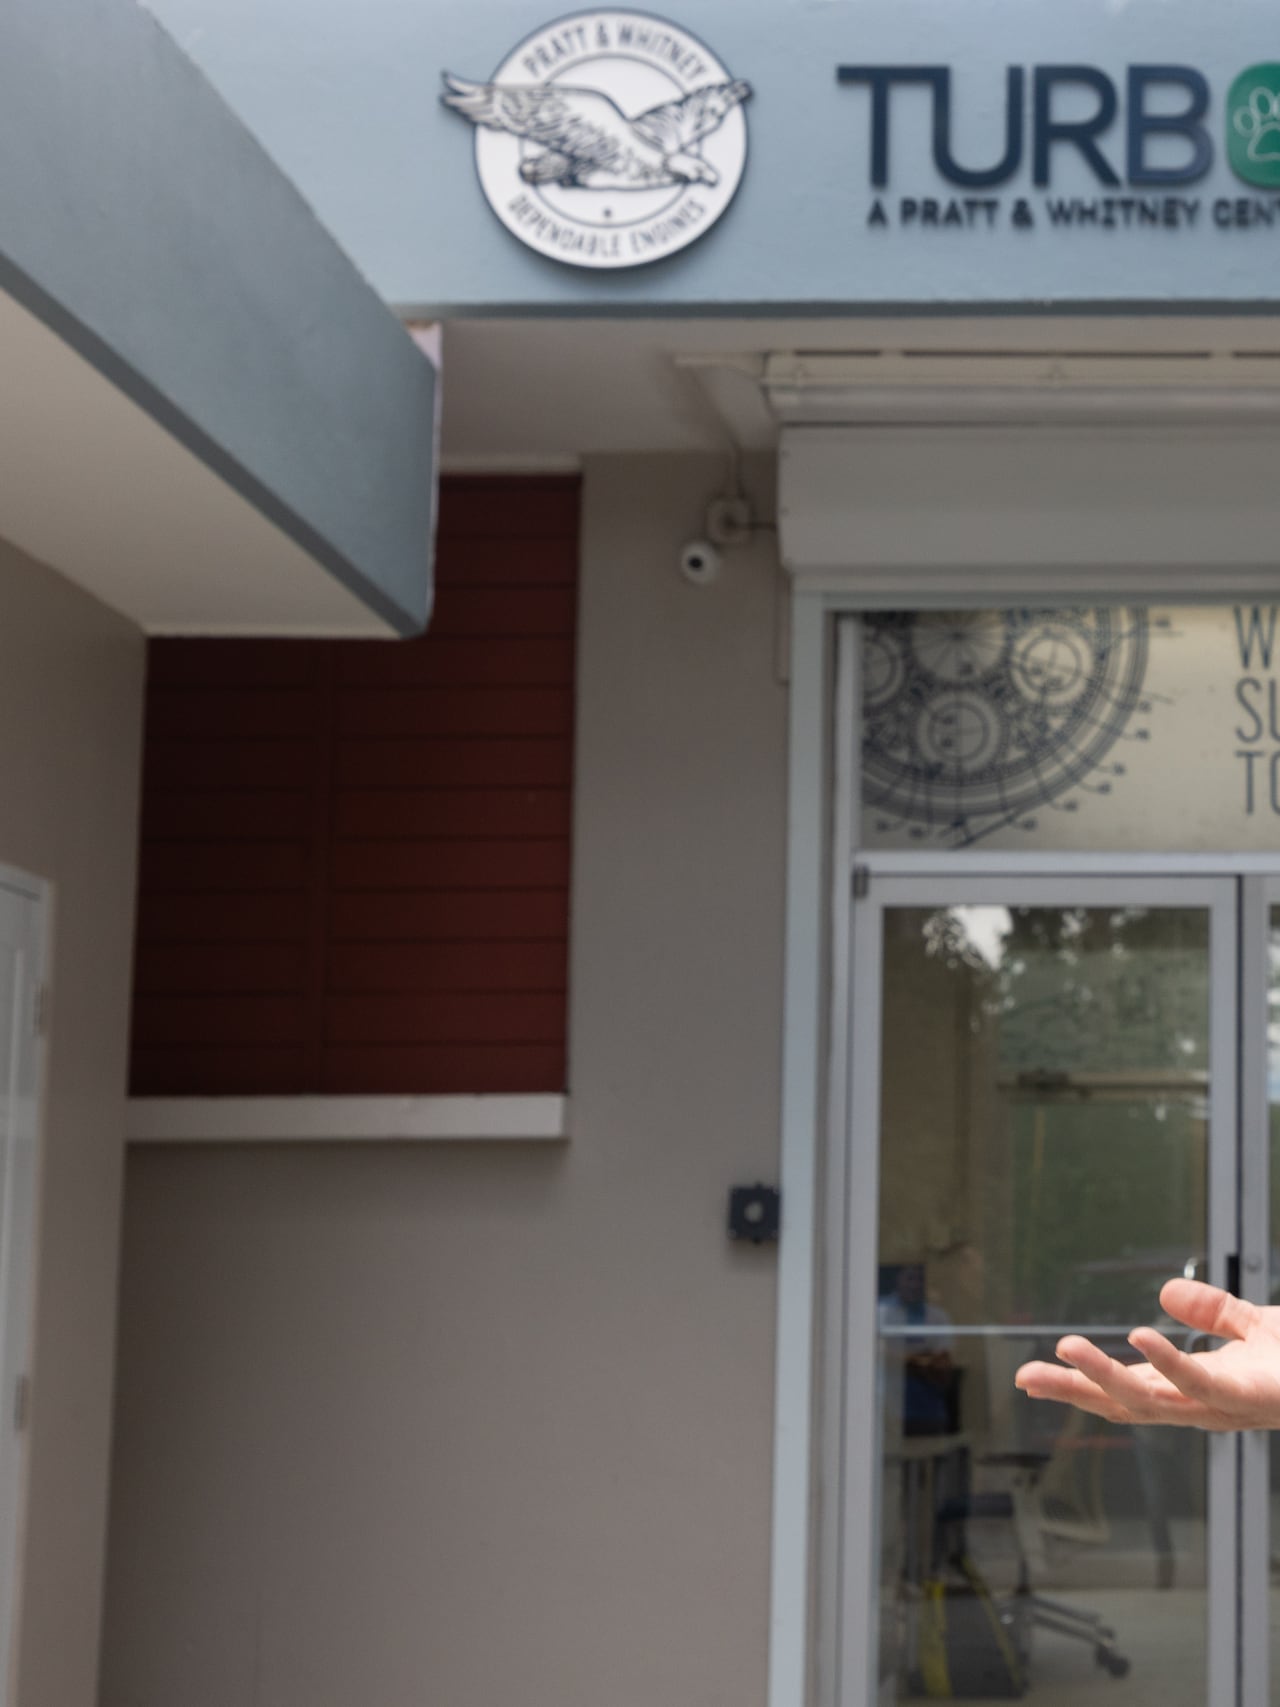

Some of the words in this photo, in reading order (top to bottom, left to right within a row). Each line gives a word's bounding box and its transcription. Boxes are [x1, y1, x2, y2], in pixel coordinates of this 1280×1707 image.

[523, 24, 586, 77] PRATT
[597, 23, 609, 47] &
[618, 24, 706, 77] WHITNEY
[508, 195, 620, 257] DEPENDABLE
[867, 199, 889, 229] A
[900, 199, 999, 229] PRATT
[1011, 198, 1034, 229] &
[1045, 199, 1199, 229] WHITNEY
